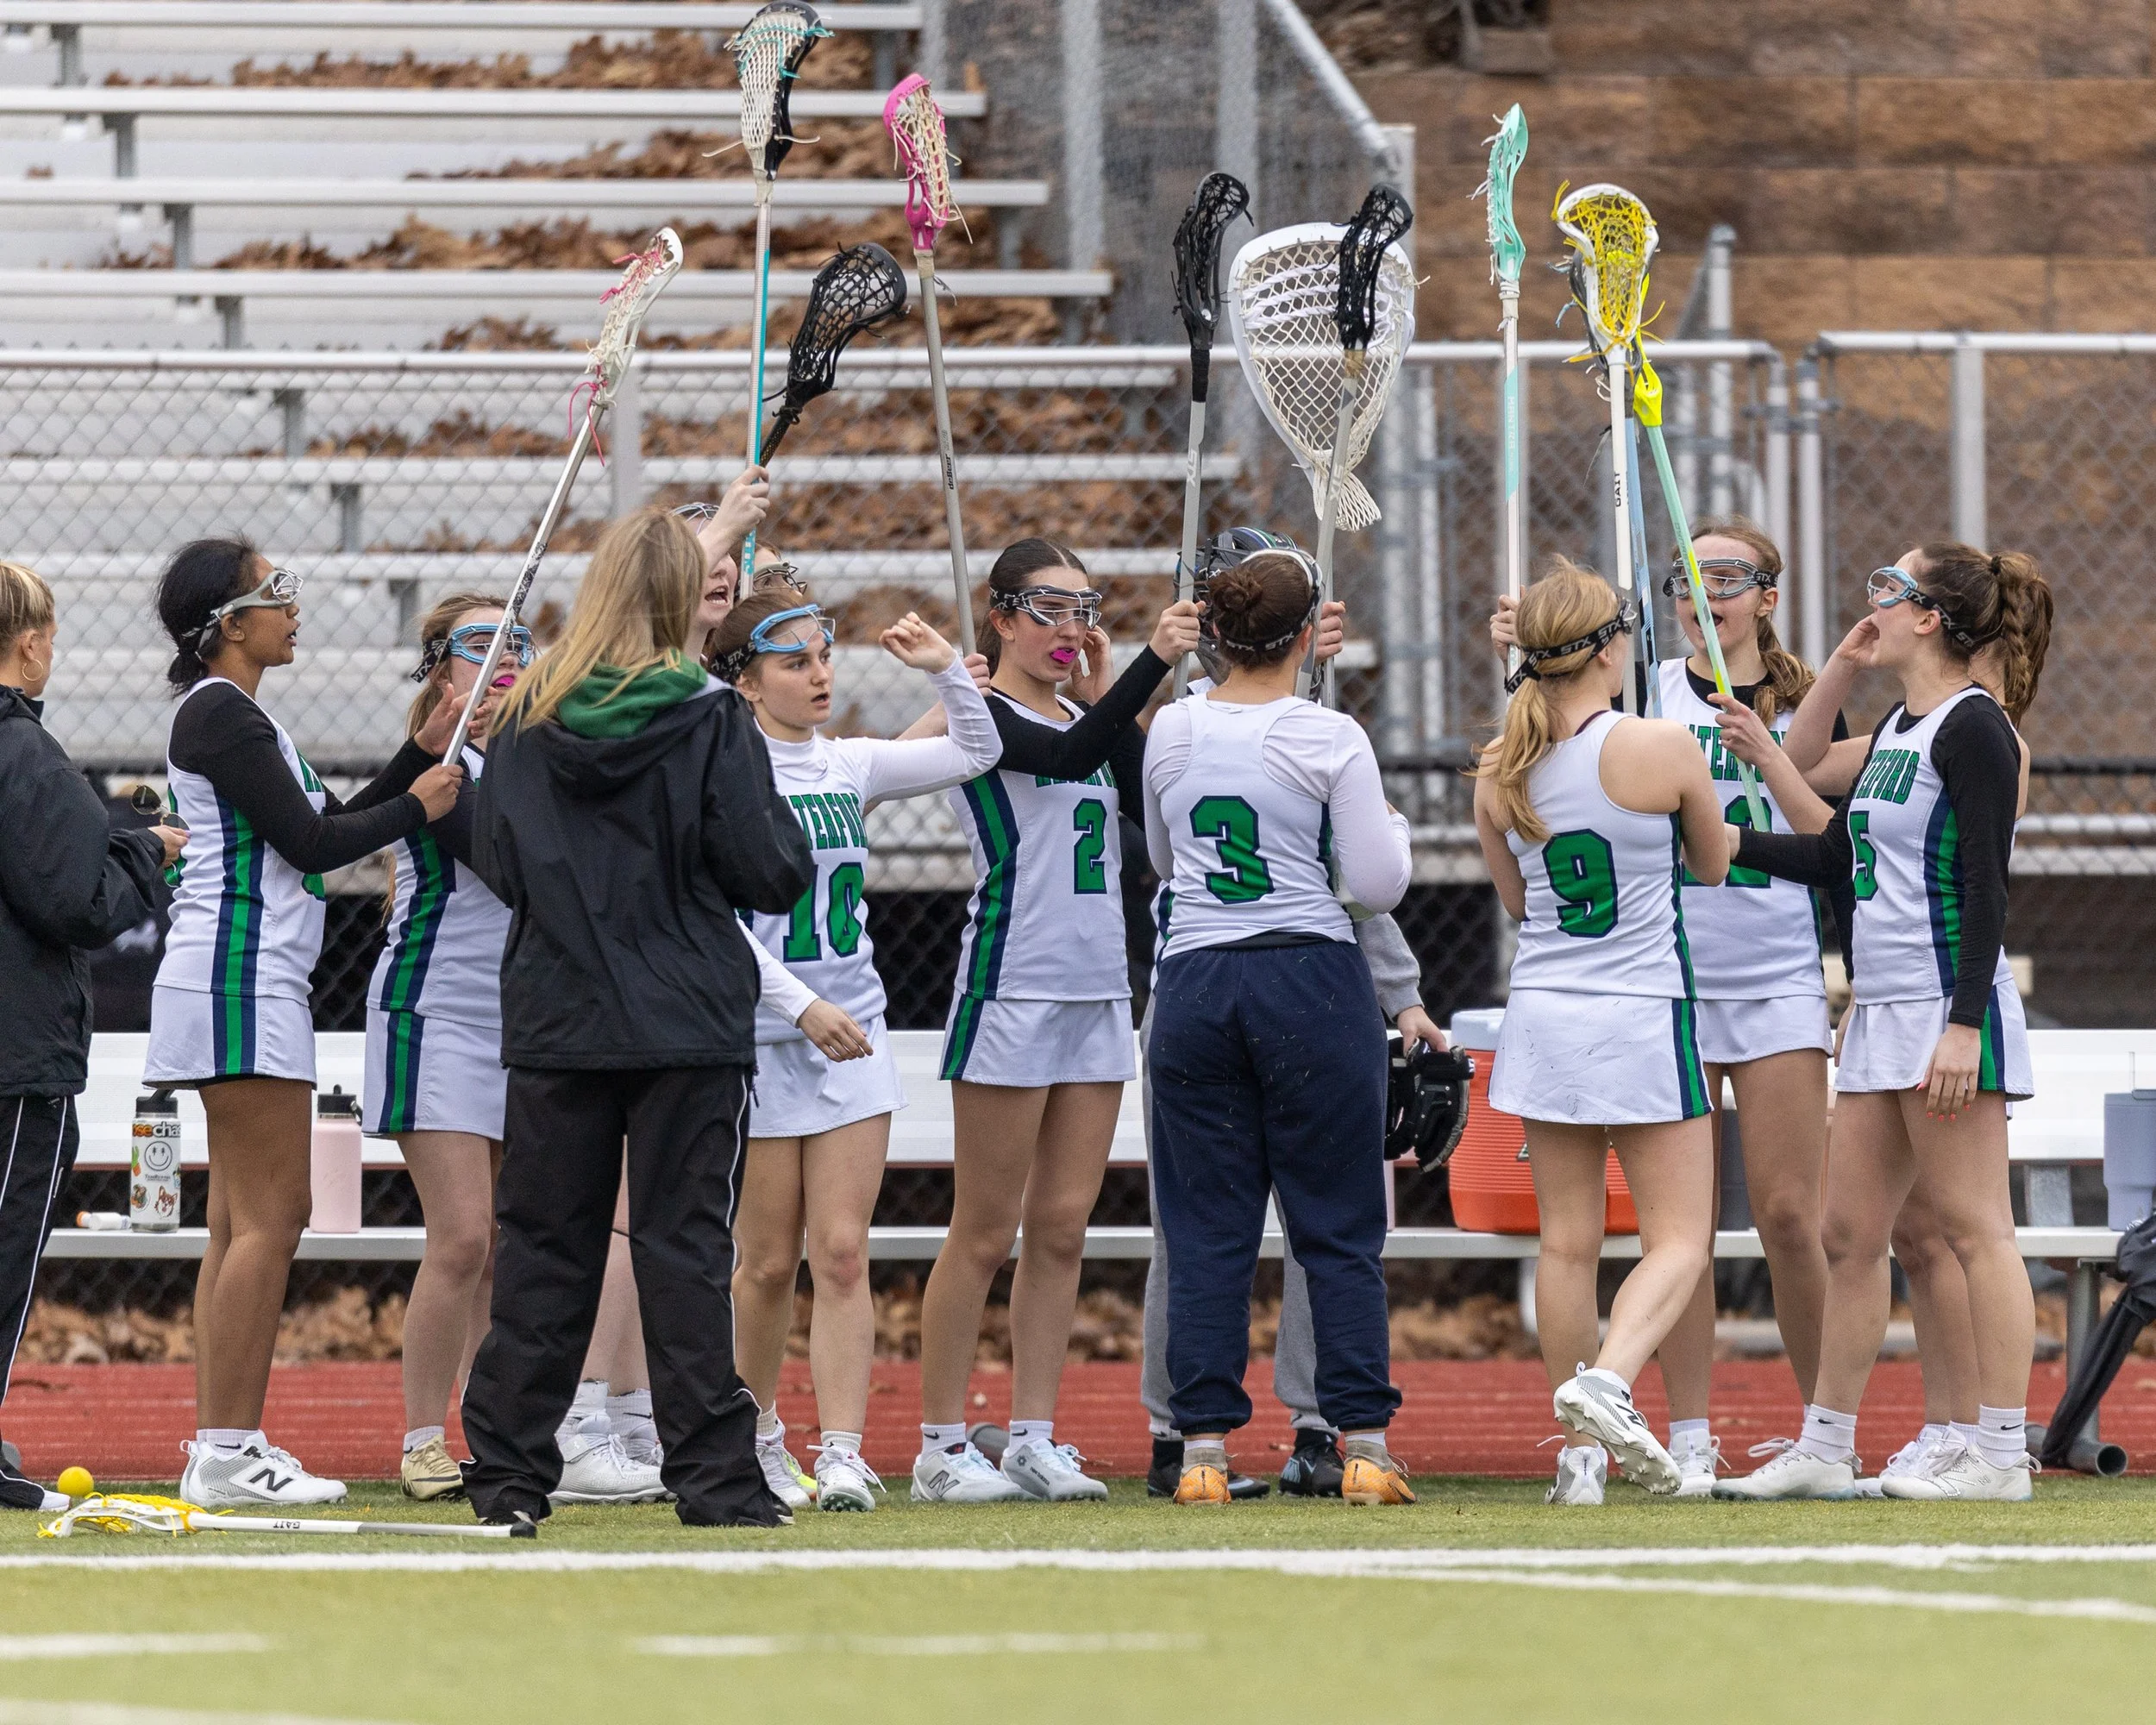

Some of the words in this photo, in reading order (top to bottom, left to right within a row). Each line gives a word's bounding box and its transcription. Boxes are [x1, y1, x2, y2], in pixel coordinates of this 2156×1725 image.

[1186, 448, 1198, 487] STX
[1755, 572, 1772, 583] STX
[1560, 636, 1591, 656] STX
[1597, 619, 1622, 640] STX
[727, 647, 746, 666] STX
[1073, 797, 1108, 895] 2
[1188, 795, 1276, 906] 3
[1849, 810, 1879, 901] 5
[1541, 827, 1620, 938] 9
[782, 862, 865, 963] 10
[273, 1521, 301, 1529] GAIT
